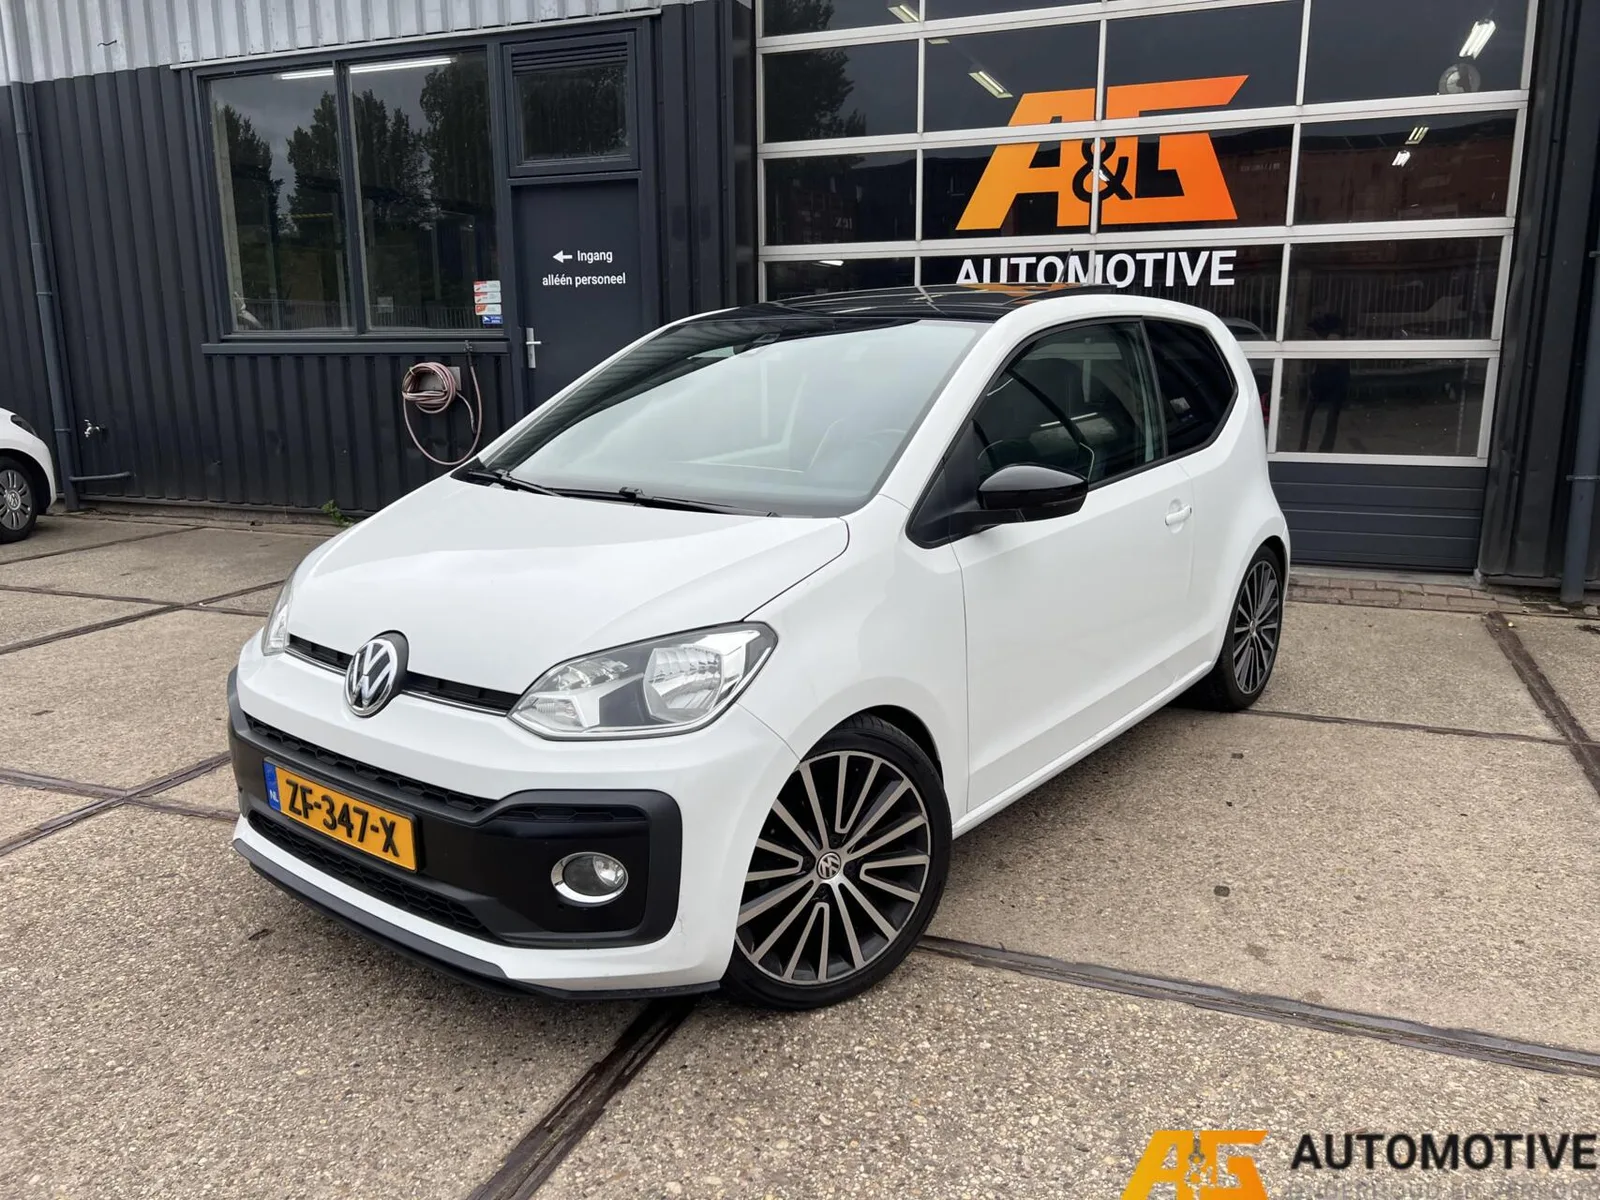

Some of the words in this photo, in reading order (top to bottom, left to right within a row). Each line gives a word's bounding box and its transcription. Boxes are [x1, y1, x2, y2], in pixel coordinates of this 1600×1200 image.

[577, 250, 613, 264] Ingang
[956, 250, 1237, 287] AUTOMOTIVE
[542, 273, 573, 286] alléén
[575, 272, 626, 288] personeel
[269, 790, 279, 803] NL
[285, 778, 400, 858] ZF-347-X
